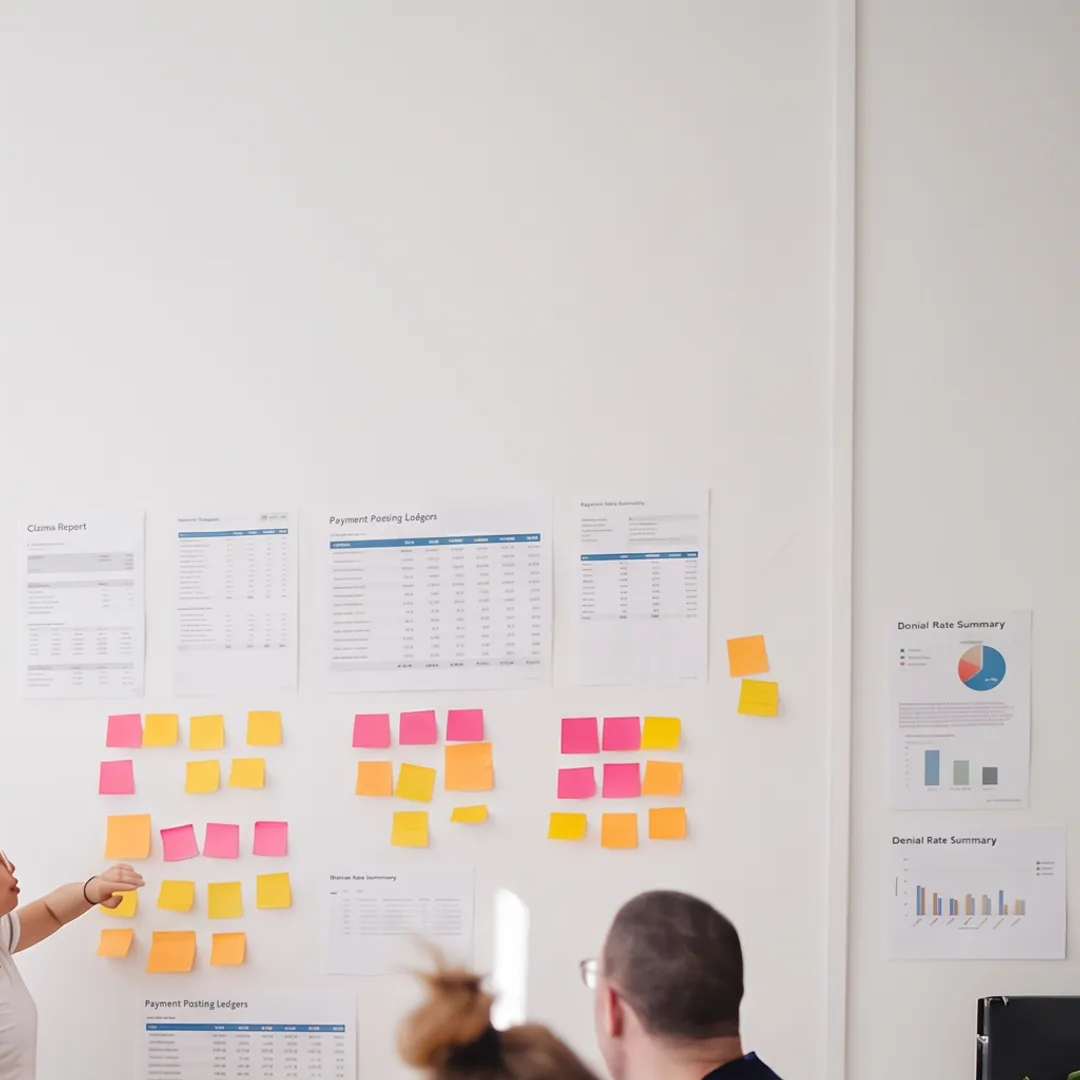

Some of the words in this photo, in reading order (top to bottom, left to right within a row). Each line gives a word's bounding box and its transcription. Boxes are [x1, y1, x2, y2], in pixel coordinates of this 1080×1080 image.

[329, 515, 368, 527] Payment
[932, 621, 955, 630] Rate
[956, 620, 1006, 631] Summary
[891, 836, 925, 845] Denial
[926, 835, 948, 845] Rate
[949, 835, 998, 847] Summary
[144, 999, 182, 1011] Payment
[183, 999, 216, 1011] Posting
[216, 999, 249, 1011] Ledgers
